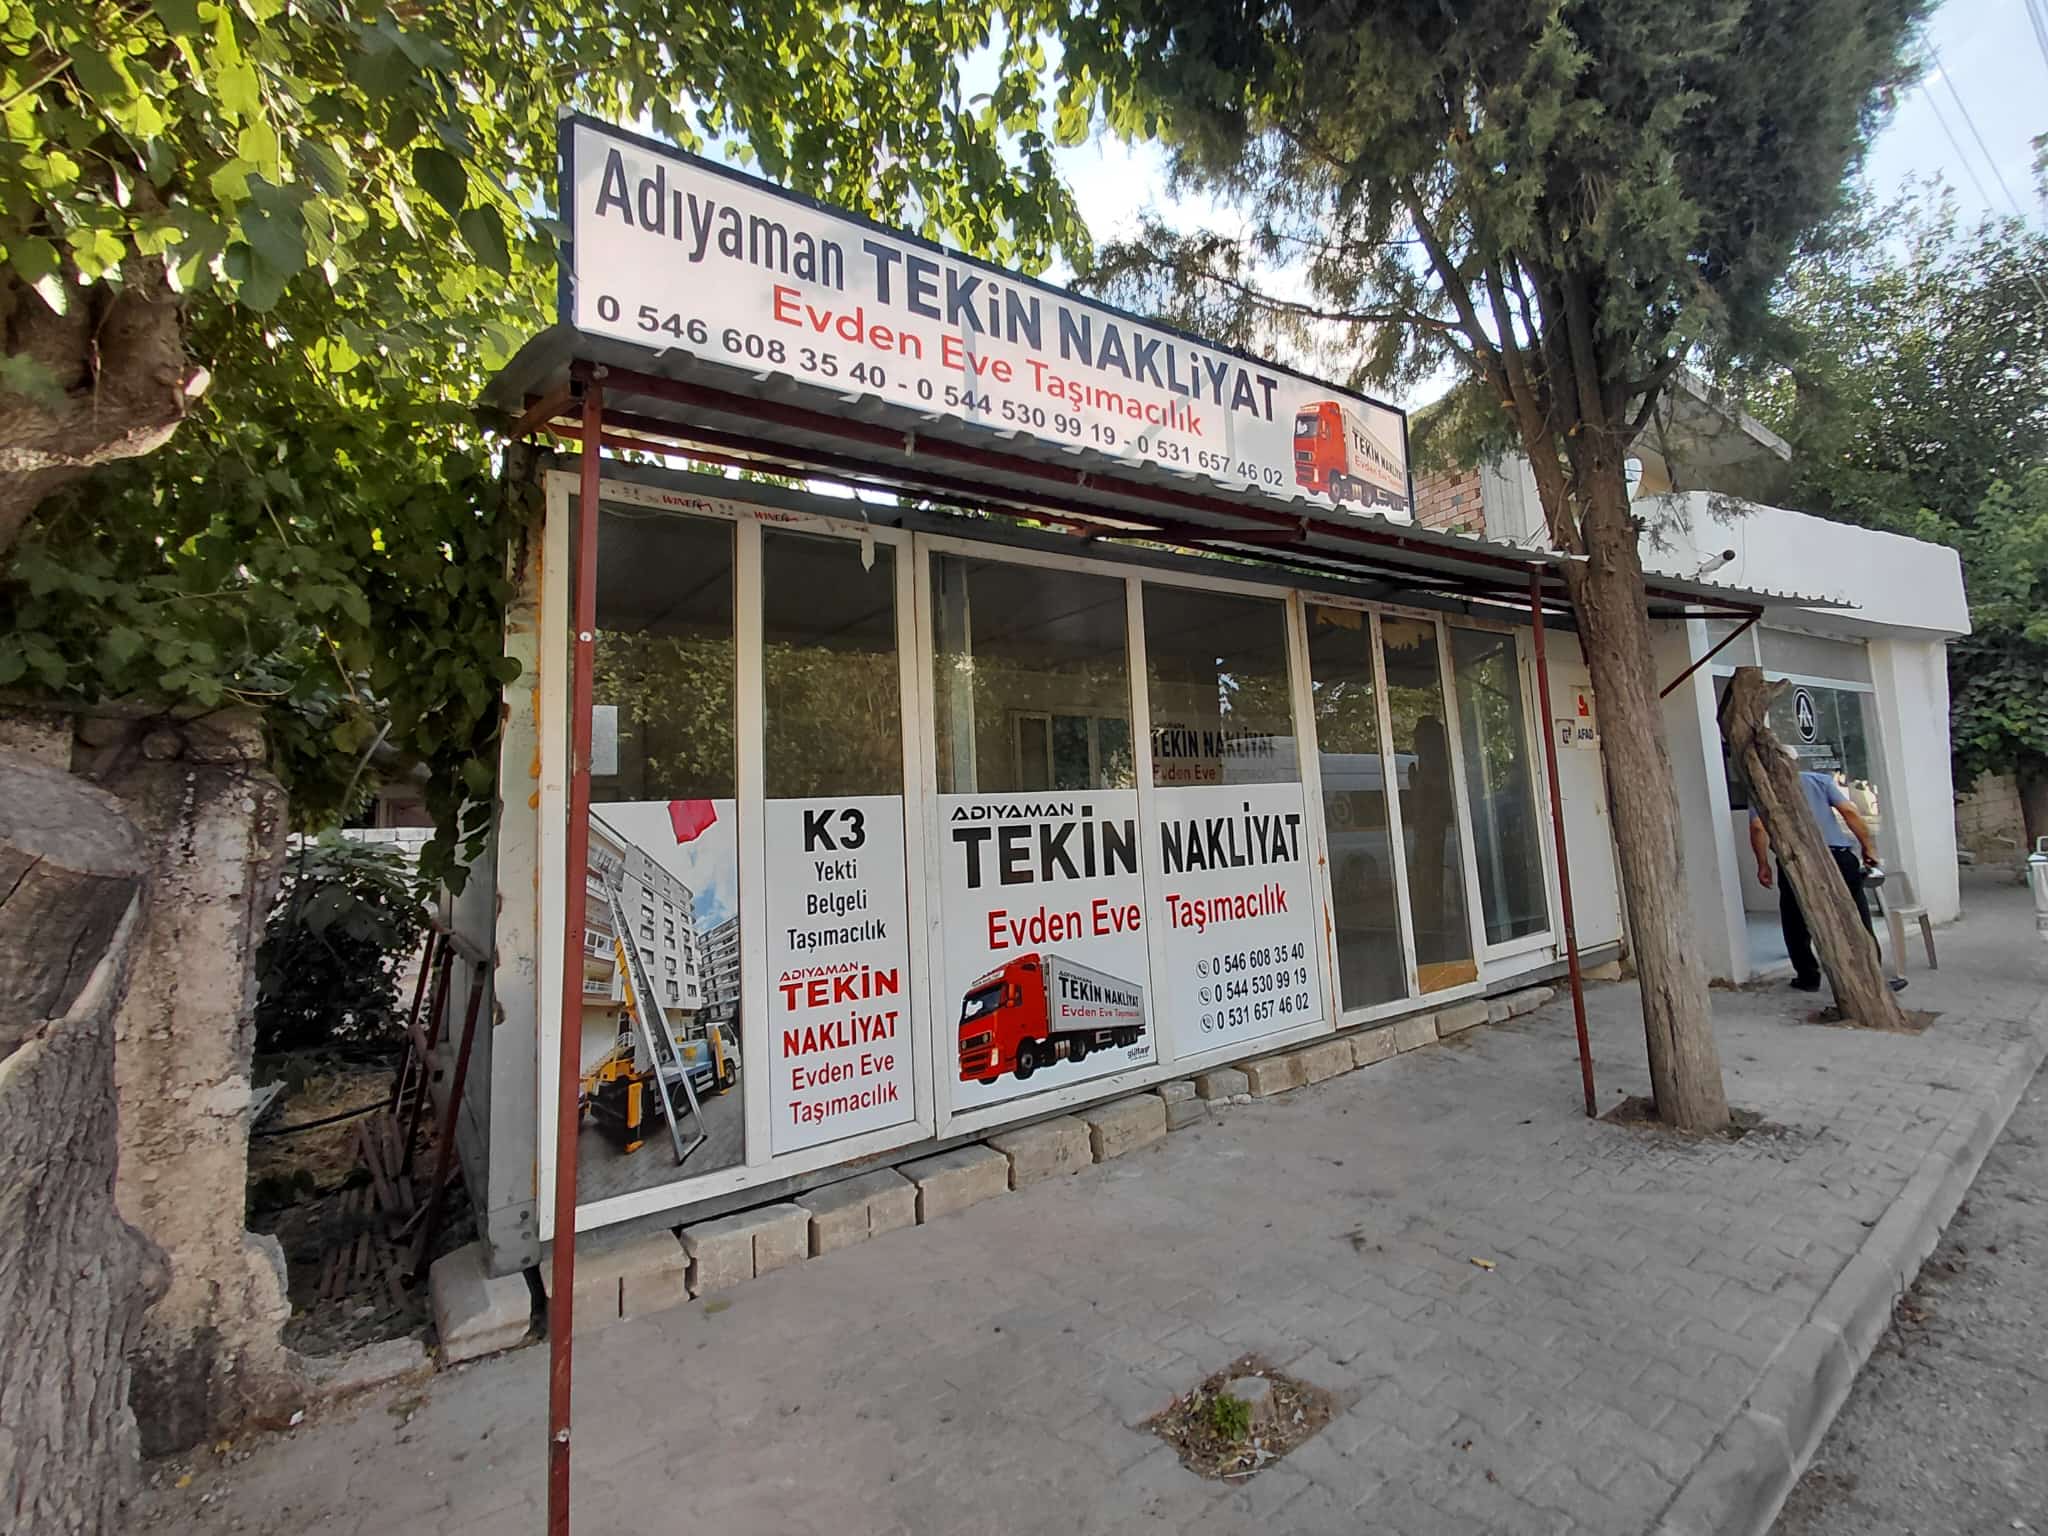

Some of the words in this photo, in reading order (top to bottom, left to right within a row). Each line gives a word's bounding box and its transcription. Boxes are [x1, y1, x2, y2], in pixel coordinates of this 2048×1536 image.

[595, 147, 844, 291] Adıyaman
[773, 284, 922, 360] Evden
[941, 334, 1013, 383] Eve
[1025, 358, 1203, 436] Taşımacılık
[597, 295, 620, 322] 0
[637, 305, 708, 345] 546
[722, 328, 786, 364] 608
[799, 348, 839, 377] 35
[849, 363, 886, 388] 40
[917, 378, 933, 400] 0
[944, 385, 992, 415] 544
[1002, 399, 1046, 428] 530
[1054, 414, 1081, 437] 99
[1091, 423, 1115, 445] 19
[1137, 435, 1149, 454] 0
[1156, 440, 1190, 464] 531
[1199, 450, 1230, 473] 657
[1237, 461, 1258, 481] 46
[1263, 467, 1284, 487] 02
[1194, 764, 1217, 780] Eve
[803, 808, 866, 852] K3
[950, 803, 1074, 821] ADIYAMAN
[952, 805, 1138, 889] TEKİN
[1161, 801, 1300, 875] NAKLİYAT
[814, 859, 857, 882] Yekti
[807, 889, 867, 916] Belgeli
[988, 905, 1082, 950] Evden
[1092, 899, 1141, 936] Eve
[1166, 882, 1288, 934] Taşımacılık
[787, 919, 887, 952] Taşımacılık
[779, 961, 859, 982] ADIYAMAN
[1212, 957, 1220, 975] 0
[1224, 952, 1247, 973] 546
[1250, 948, 1271, 968] 608
[1274, 945, 1288, 963] 35
[1291, 942, 1304, 960] 40
[779, 965, 899, 1011] TEKİN
[1215, 984, 1222, 1002] 0
[1226, 979, 1248, 1000] 544
[1252, 974, 1273, 994] 530
[1276, 970, 1290, 989] 99
[1294, 967, 1307, 984] 19
[1061, 1004, 1097, 1017] Evden
[1217, 1011, 1224, 1029] 0
[1229, 1005, 1250, 1026] 531
[1254, 1000, 1275, 1020] 657
[1279, 996, 1292, 1014] 46
[1295, 992, 1309, 1010] 02
[783, 1010, 899, 1058] NAKLİYAT
[792, 1060, 854, 1091] Evden
[860, 1053, 895, 1075] Eve
[789, 1081, 898, 1125] Taşımacılık
